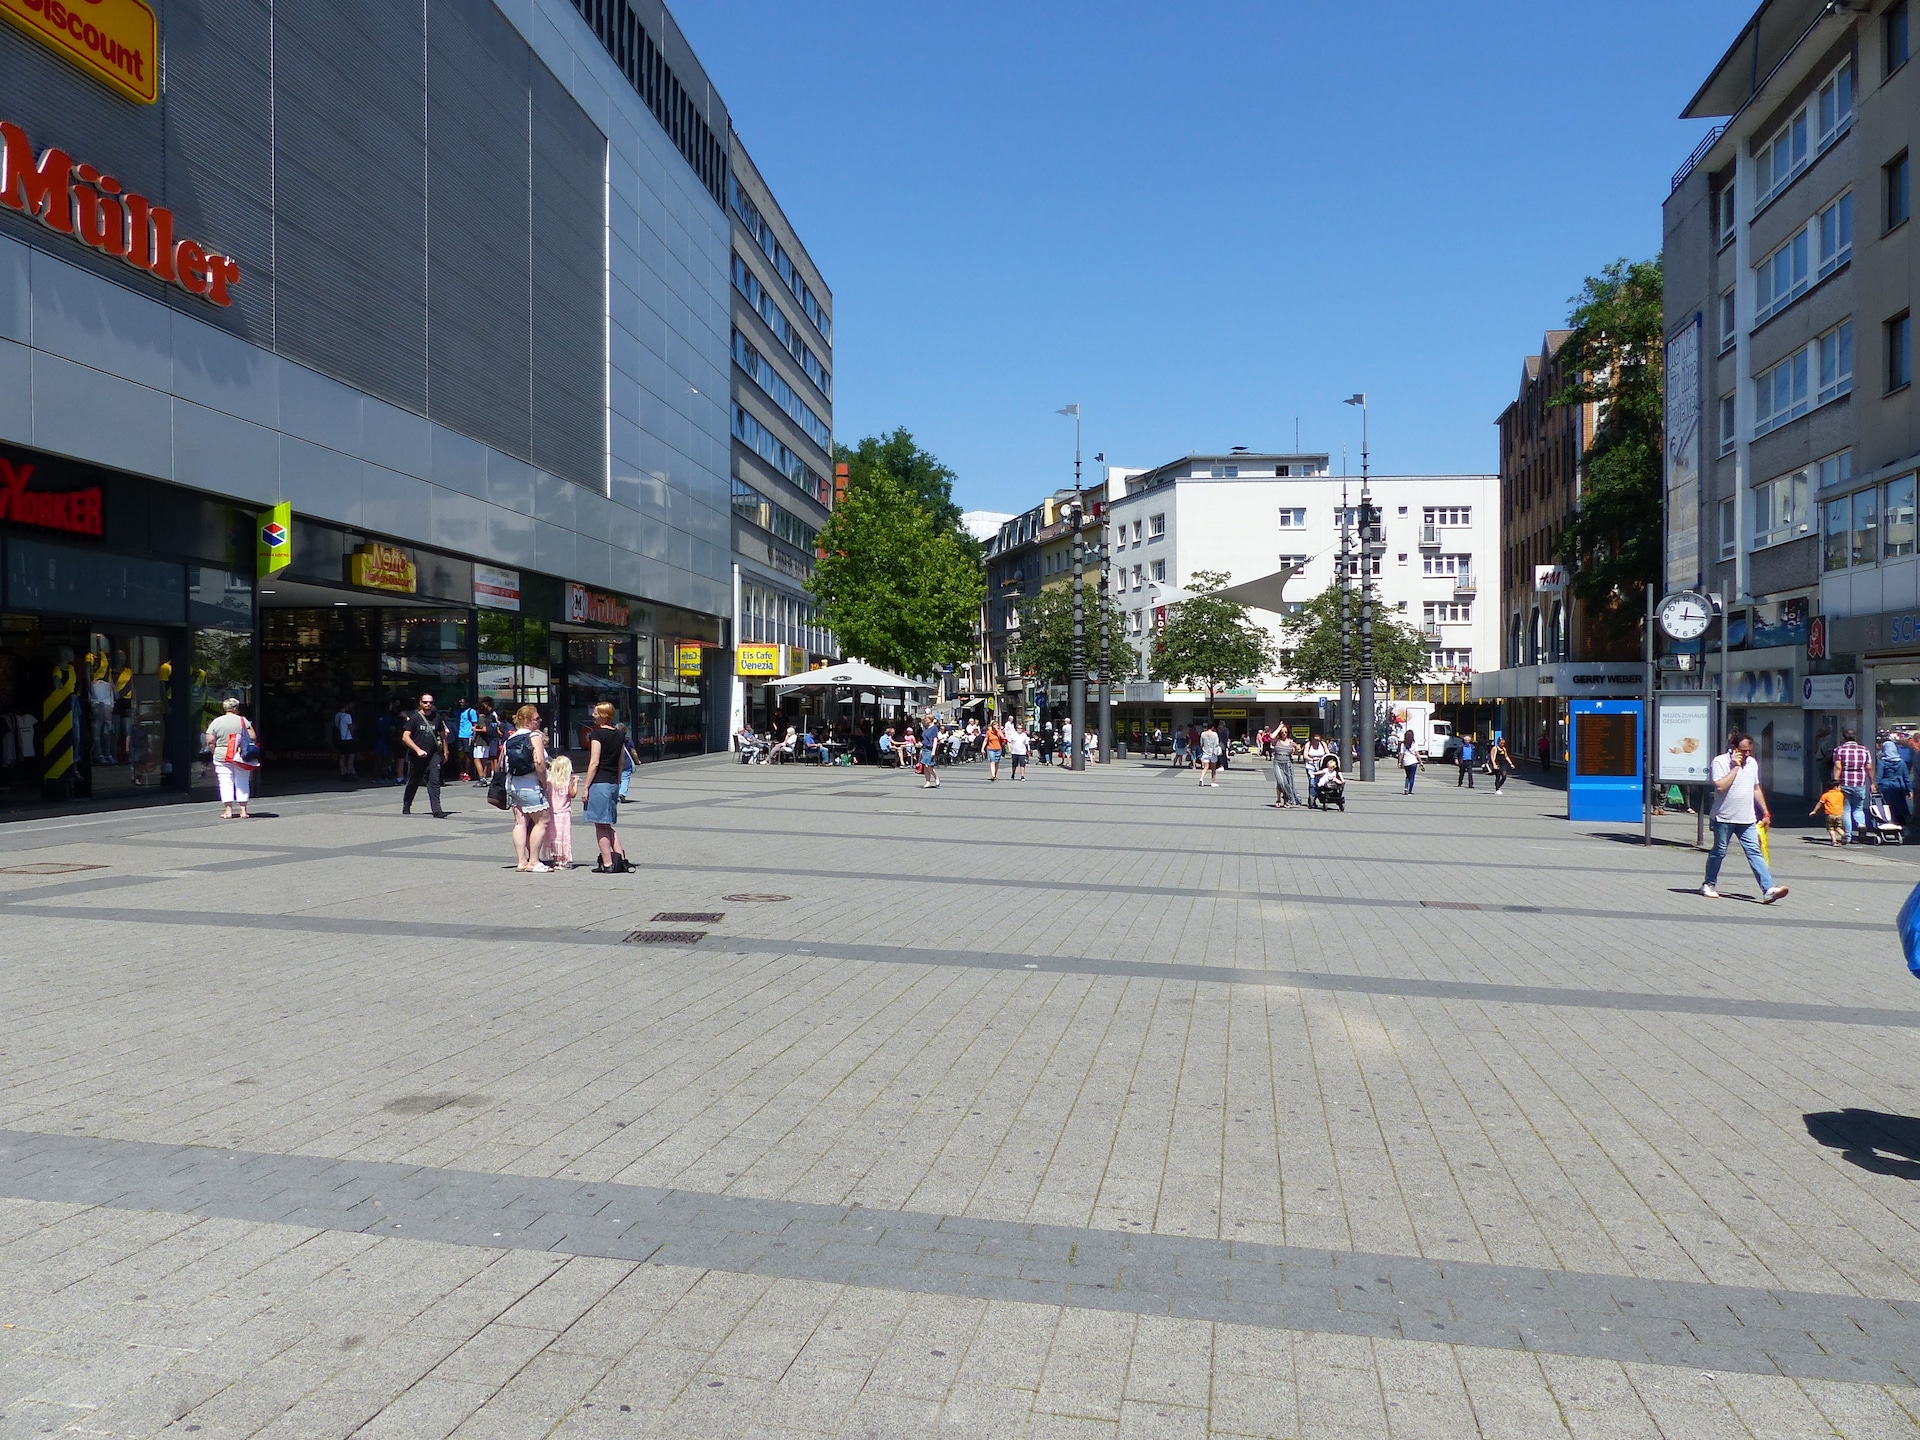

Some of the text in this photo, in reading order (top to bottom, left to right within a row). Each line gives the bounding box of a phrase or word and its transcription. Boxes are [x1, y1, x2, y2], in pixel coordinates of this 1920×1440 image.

[0, 121, 240, 306] Müller
[372, 543, 408, 573] Netto
[1538, 571, 1561, 586] H&M
[585, 591, 630, 627] Müller
[1572, 674, 1642, 684] GERRY WEBER
